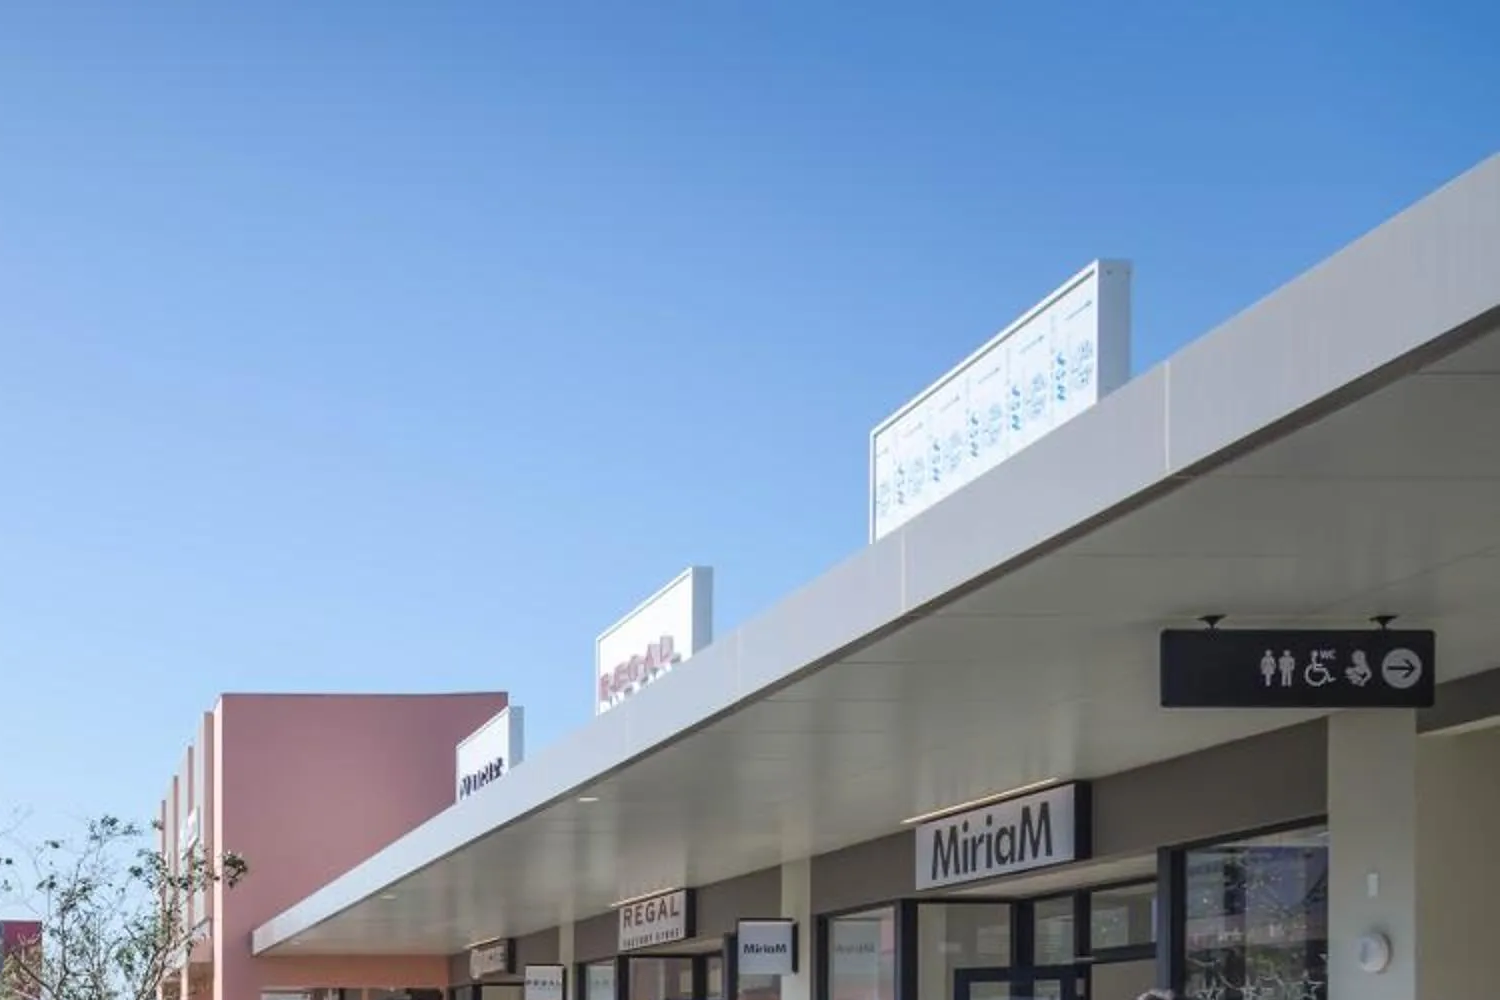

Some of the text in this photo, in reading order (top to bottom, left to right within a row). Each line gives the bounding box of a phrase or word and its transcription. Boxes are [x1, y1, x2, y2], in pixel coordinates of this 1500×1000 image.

[931, 801, 1053, 881] MiriaM
[623, 895, 680, 930] REGAL
[743, 943, 787, 955] MiriaM
